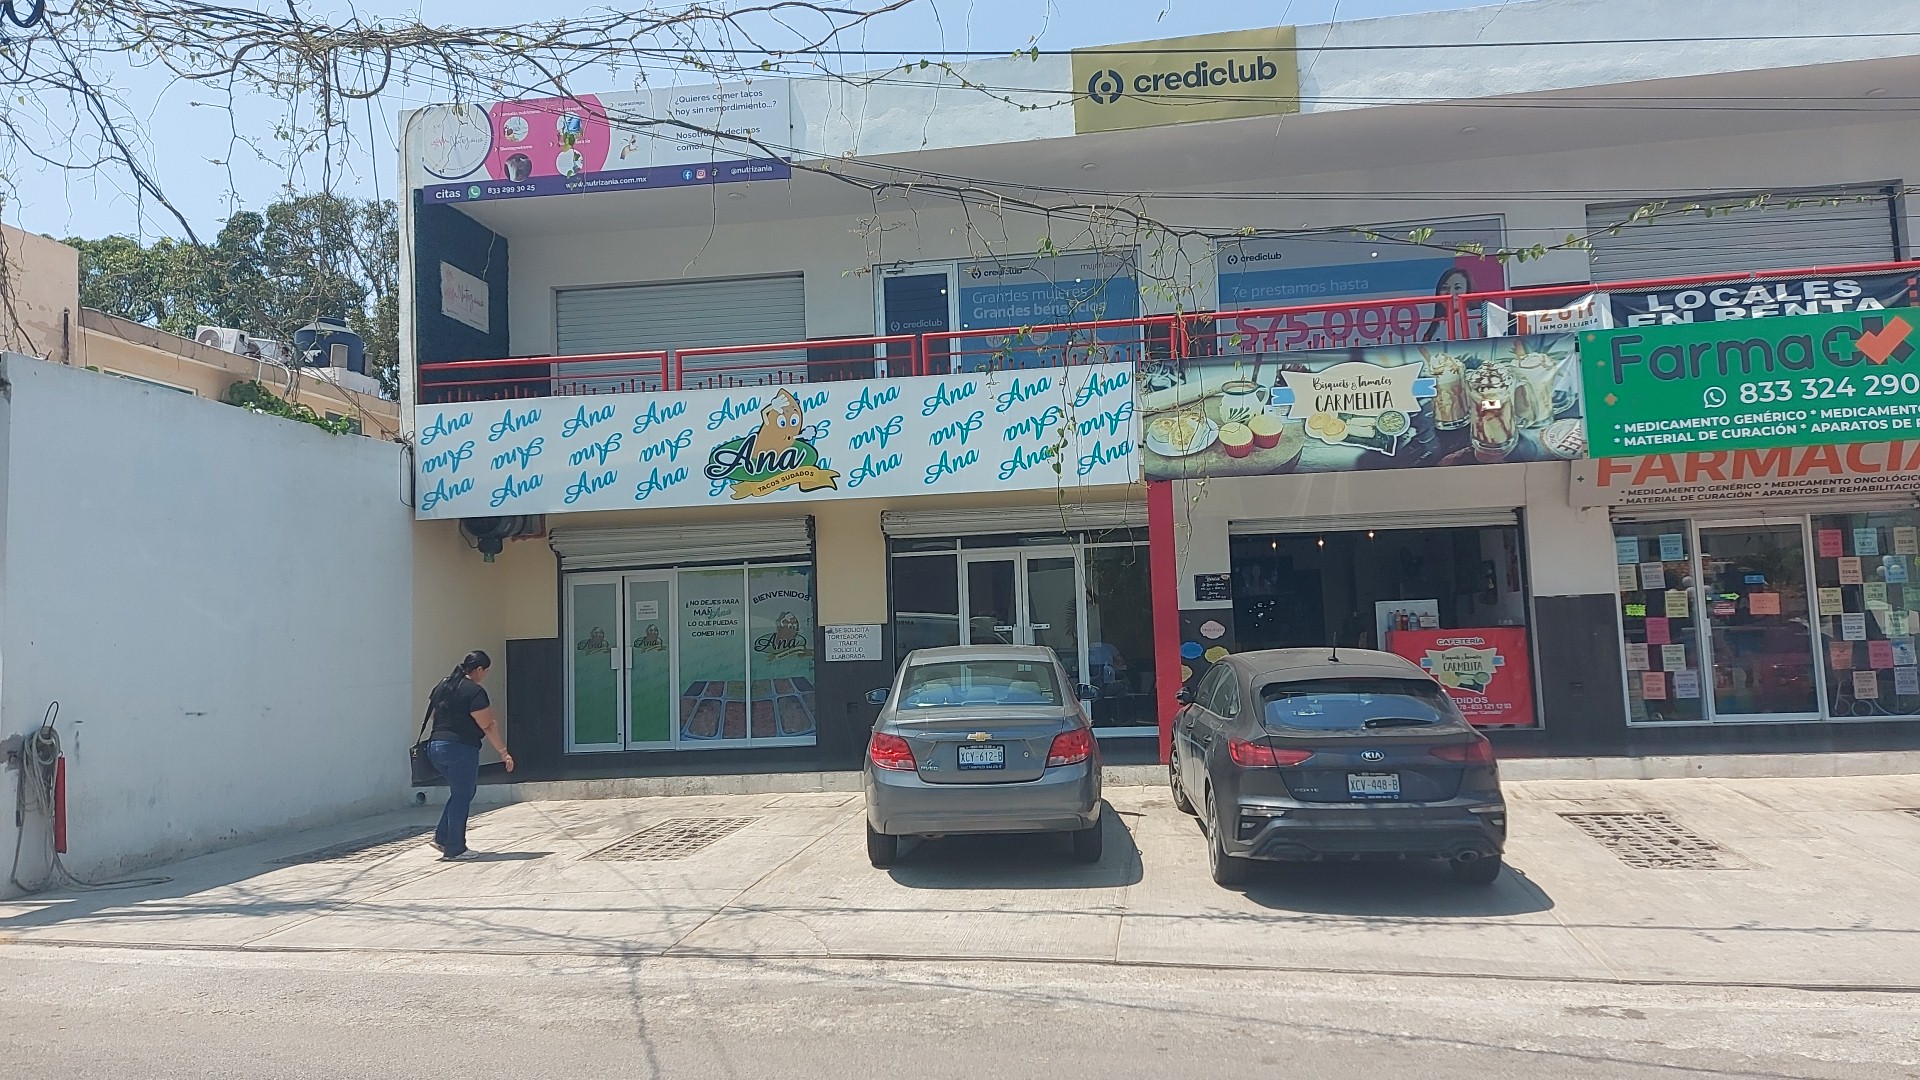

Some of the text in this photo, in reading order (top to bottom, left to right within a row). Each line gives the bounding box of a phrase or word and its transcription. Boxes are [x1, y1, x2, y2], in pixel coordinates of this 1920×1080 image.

[1133, 56, 1277, 93] crediclub
[712, 92, 738, 100] comer
[740, 90, 763, 98] tacos
[675, 108, 690, 116] hoy
[730, 165, 773, 175] @nutrizania
[435, 188, 461, 199] citas
[487, 186, 500, 194] 833
[502, 186, 515, 194] 299
[516, 185, 525, 193] 30
[1240, 252, 1282, 261] crediclub
[972, 290, 1033, 305] Grandes
[1251, 281, 1326, 300] prestamos
[1330, 278, 1369, 291] hasta
[1647, 279, 1862, 312] LOCALES
[973, 304, 1032, 319] Grandes
[1628, 297, 1886, 328] EN RENTA
[903, 318, 943, 329] crediclub
[1312, 376, 1349, 391] Bisquets
[1356, 375, 1392, 388] Tamales
[1740, 373, 1920, 404] 833 324 290
[1315, 390, 1394, 412] CARMELITA
[421, 412, 473, 446] Ana
[488, 408, 542, 442] Ana
[562, 404, 616, 438] Ana
[633, 400, 688, 434] Ana
[707, 397, 762, 430] Ana
[845, 386, 901, 420] Ana
[921, 381, 978, 416] Ana
[996, 376, 1052, 413] Ana
[1624, 415, 1731, 433] MEDICAMENTO
[1733, 411, 1807, 425] GENÉRICO
[1624, 432, 1695, 447] MATERIAL
[1698, 430, 1719, 441] DE
[1721, 423, 1797, 439] CURACIÓN
[1811, 419, 1888, 433] APARATOS
[1892, 418, 1912, 429] DE
[704, 433, 806, 480] Ana
[1597, 440, 1920, 487] FARMACI
[422, 477, 475, 512] Ana
[489, 474, 544, 508] Ana
[564, 470, 618, 504] Ana
[635, 466, 689, 500] Ana
[847, 453, 903, 488] Ana
[924, 449, 980, 484] Ana
[758, 471, 815, 492] TACOS SUDADOS
[1628, 486, 1706, 496] MEDICAMENTO
[1708, 482, 1762, 492] GENÉRICO
[1771, 478, 1851, 488] MEDICAMENTO
[1626, 495, 1677, 505] MATERIAL
[1697, 491, 1752, 501] CURACIÓN
[1762, 487, 1819, 497] APARATOS
[752, 590, 811, 604] BIENVENIDOS
[754, 632, 801, 653] Ana
[1437, 637, 1485, 646] CAFETERÍA
[1443, 661, 1484, 672] CARMELITA
[960, 751, 1003, 762] XCY-612-B
[1350, 779, 1398, 791] XCV-448-B
